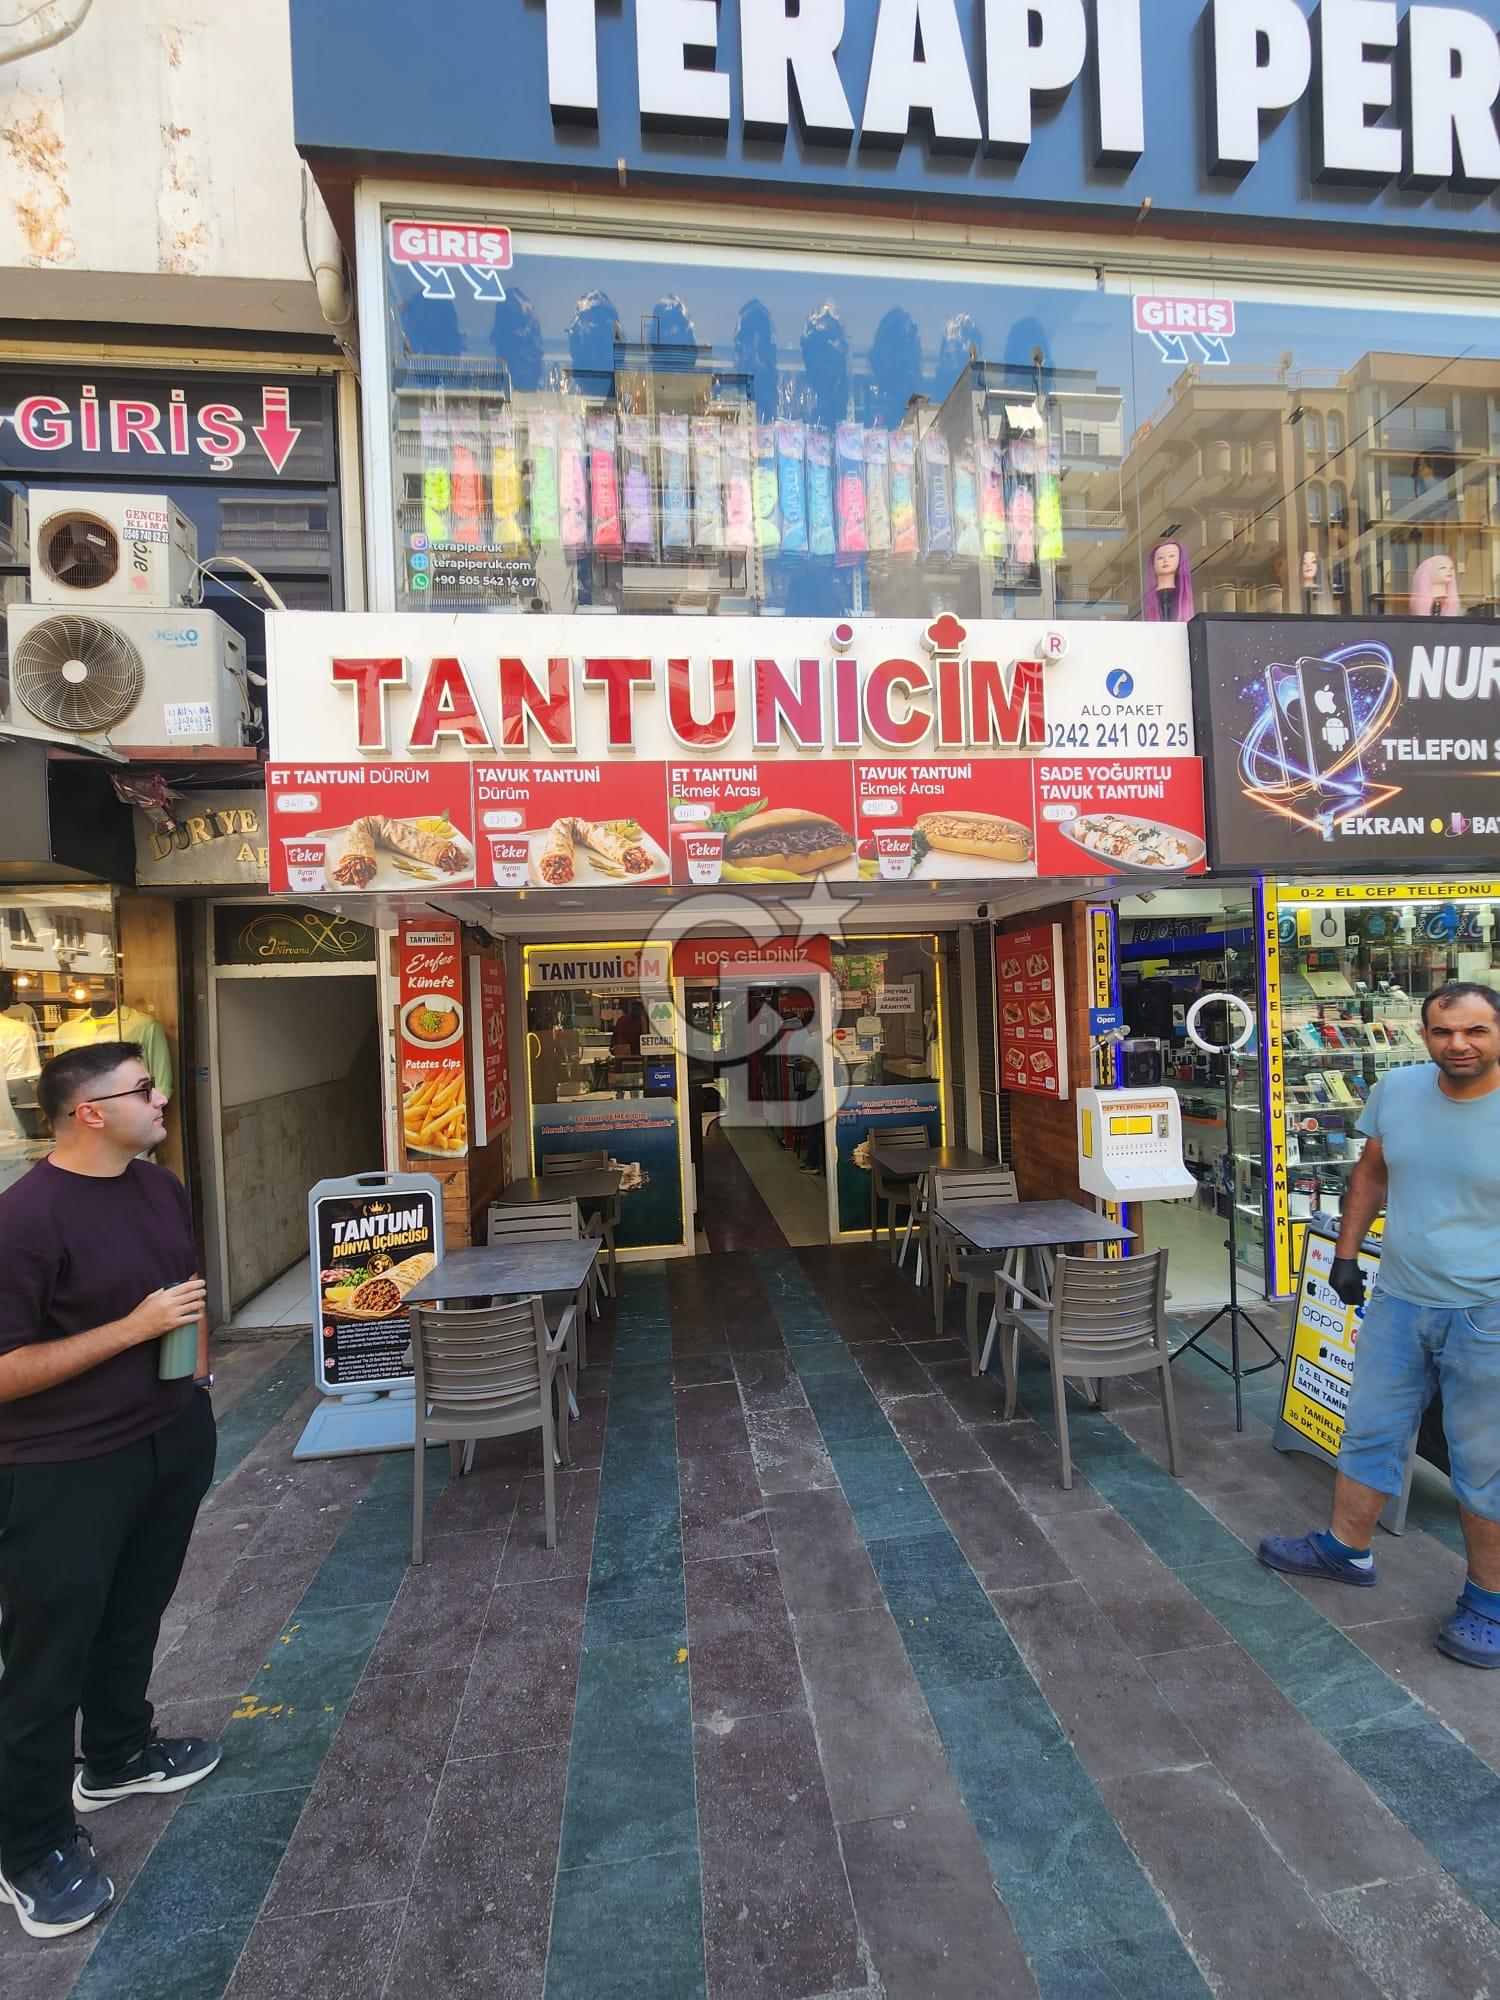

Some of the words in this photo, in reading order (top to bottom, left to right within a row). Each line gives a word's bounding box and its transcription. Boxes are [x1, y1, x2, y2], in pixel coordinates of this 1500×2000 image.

[546, 0, 1145, 160] TERAPI
[13, 384, 247, 471] GİRİŞ
[133, 540, 152, 572] arç
[432, 541, 503, 553] terapiperuk
[433, 558, 531, 571] terapiperuk.com
[434, 575, 456, 585] +90
[458, 575, 480, 585] 505
[482, 576, 504, 587] 542
[507, 577, 519, 587] 14
[521, 577, 537, 587] 07
[1407, 645, 1500, 700] NUR
[328, 612, 1047, 753] TANTUNİCİM
[1081, 704, 1111, 716] ALO
[1116, 704, 1164, 715] PAKET
[1096, 723, 1129, 747] 241
[1137, 723, 1160, 747] 02
[1166, 723, 1188, 747] 25
[1381, 738, 1488, 761] TELEFON
[271, 770, 291, 785] ET
[294, 767, 365, 785] TANTUNİ
[369, 767, 430, 784] DÜRÜM
[477, 768, 530, 783] TAVUK
[533, 765, 601, 783] TANTUNİ
[672, 768, 689, 782] ET
[692, 765, 757, 782] TANTUNİ
[859, 766, 907, 780] TAVUK
[910, 763, 972, 780] TANTUNİ
[1040, 766, 1084, 781] SADE
[1087, 763, 1172, 781] YOĞURTLU
[478, 786, 530, 801] Dürüm
[672, 785, 720, 798] Ekmek
[725, 784, 761, 797] Arası
[860, 782, 906, 795] Ekmek
[910, 781, 944, 795] Arası
[1040, 785, 1094, 800] TAVUK
[1097, 781, 1165, 800] TANTUNİ
[1341, 817, 1425, 835] EKRAN
[1336, 888, 1355, 897] EL
[1365, 887, 1397, 897] CEP
[1407, 885, 1492, 896] TELEFONU
[1266, 911, 1277, 957] CEP
[694, 950, 730, 968] HOŞ
[734, 945, 808, 964] GELDİNİZ
[1095, 929, 1108, 1002] TABLET
[538, 951, 660, 981] TANTUNİCİM
[408, 975, 455, 988] Künefe
[1096, 1016, 1116, 1025] Open
[641, 1035, 673, 1046] SETCARD
[1268, 983, 1282, 1119] TELEFONU
[405, 1059, 440, 1069] Patates
[331, 1204, 424, 1244] TANTUNİ
[333, 1239, 371, 1258] DÜNYA
[372, 1226, 429, 1253] ÜÇÜNCÜSÜ
[1302, 1305, 1344, 1333] oppo
[1297, 1376, 1320, 1396] SATIM
[1313, 1372, 1322, 1384] EL
[1289, 1409, 1299, 1420] 30
[1300, 1417, 1313, 1430] DK
[1303, 1404, 1346, 1434] TAMİRLE
